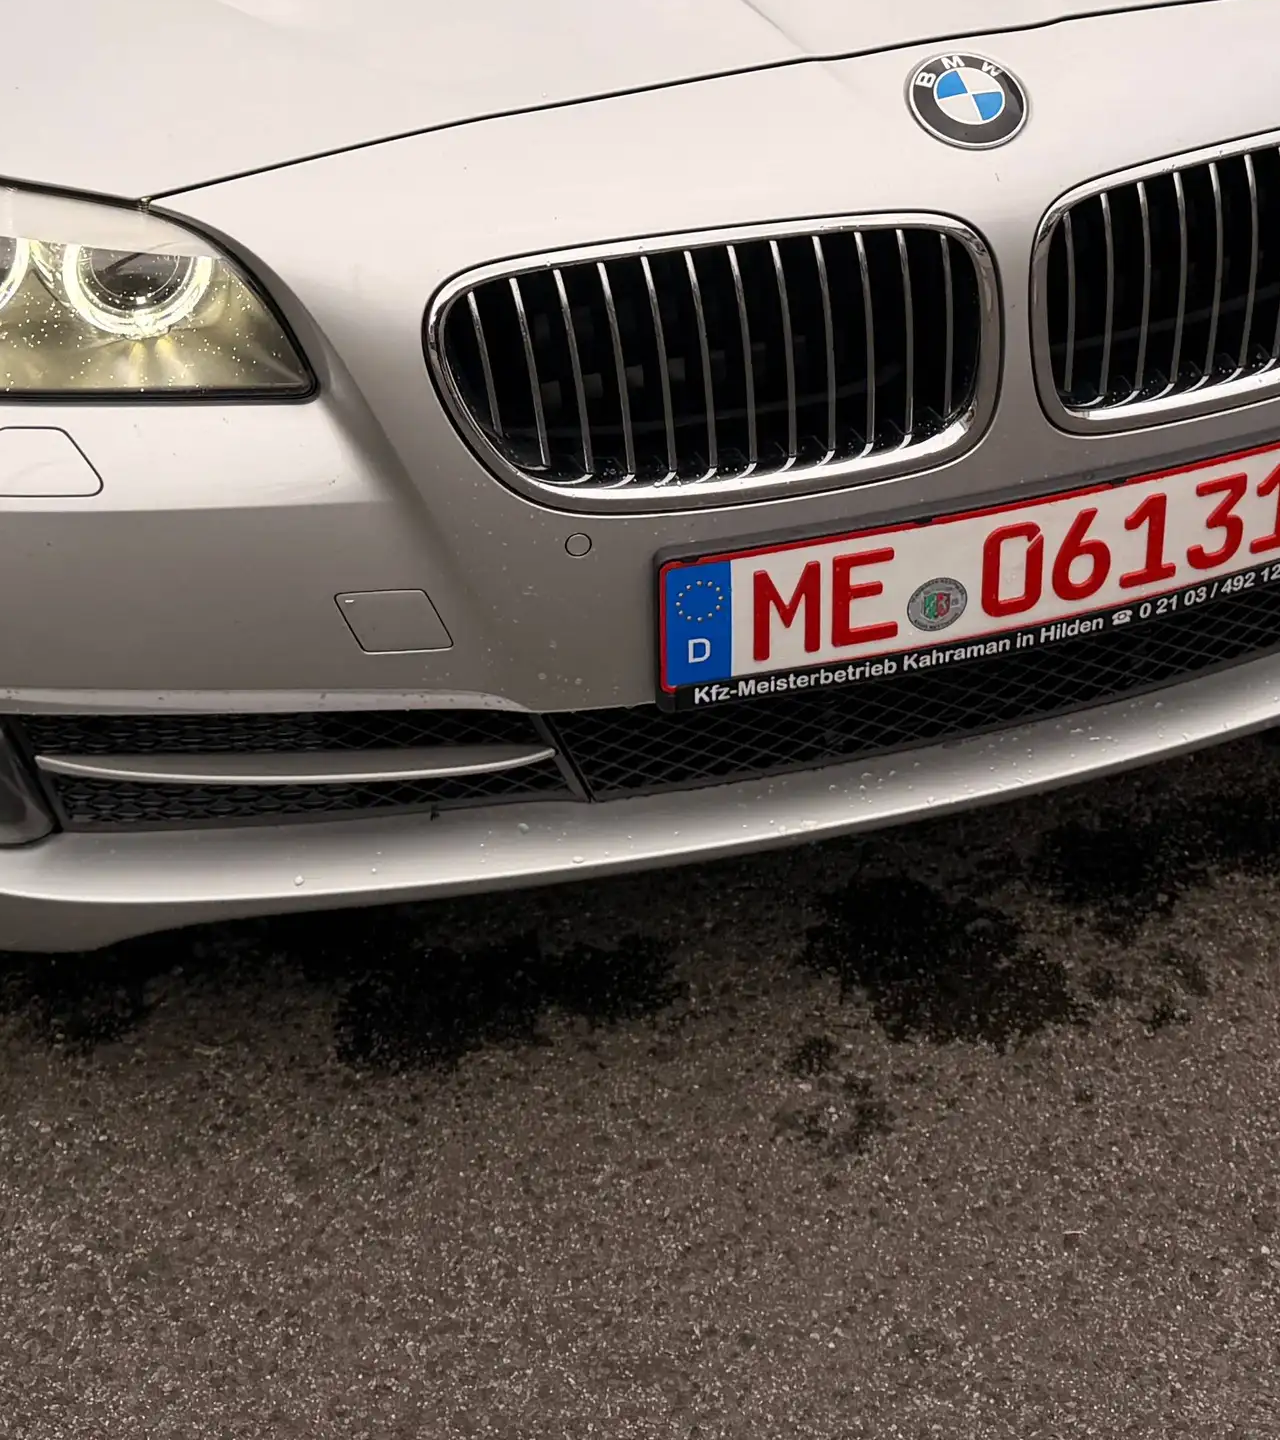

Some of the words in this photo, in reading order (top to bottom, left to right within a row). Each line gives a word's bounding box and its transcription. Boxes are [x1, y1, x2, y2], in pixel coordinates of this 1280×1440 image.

[915, 55, 1003, 88] BMW
[694, 659, 898, 705] Kfz-Meisterbetrieb
[903, 638, 1011, 672] Kahraman
[1016, 632, 1035, 649] in
[1040, 616, 1105, 644] Hilden
[1220, 571, 1255, 594] 492
[753, 546, 898, 662] ME
[688, 637, 711, 664] D
